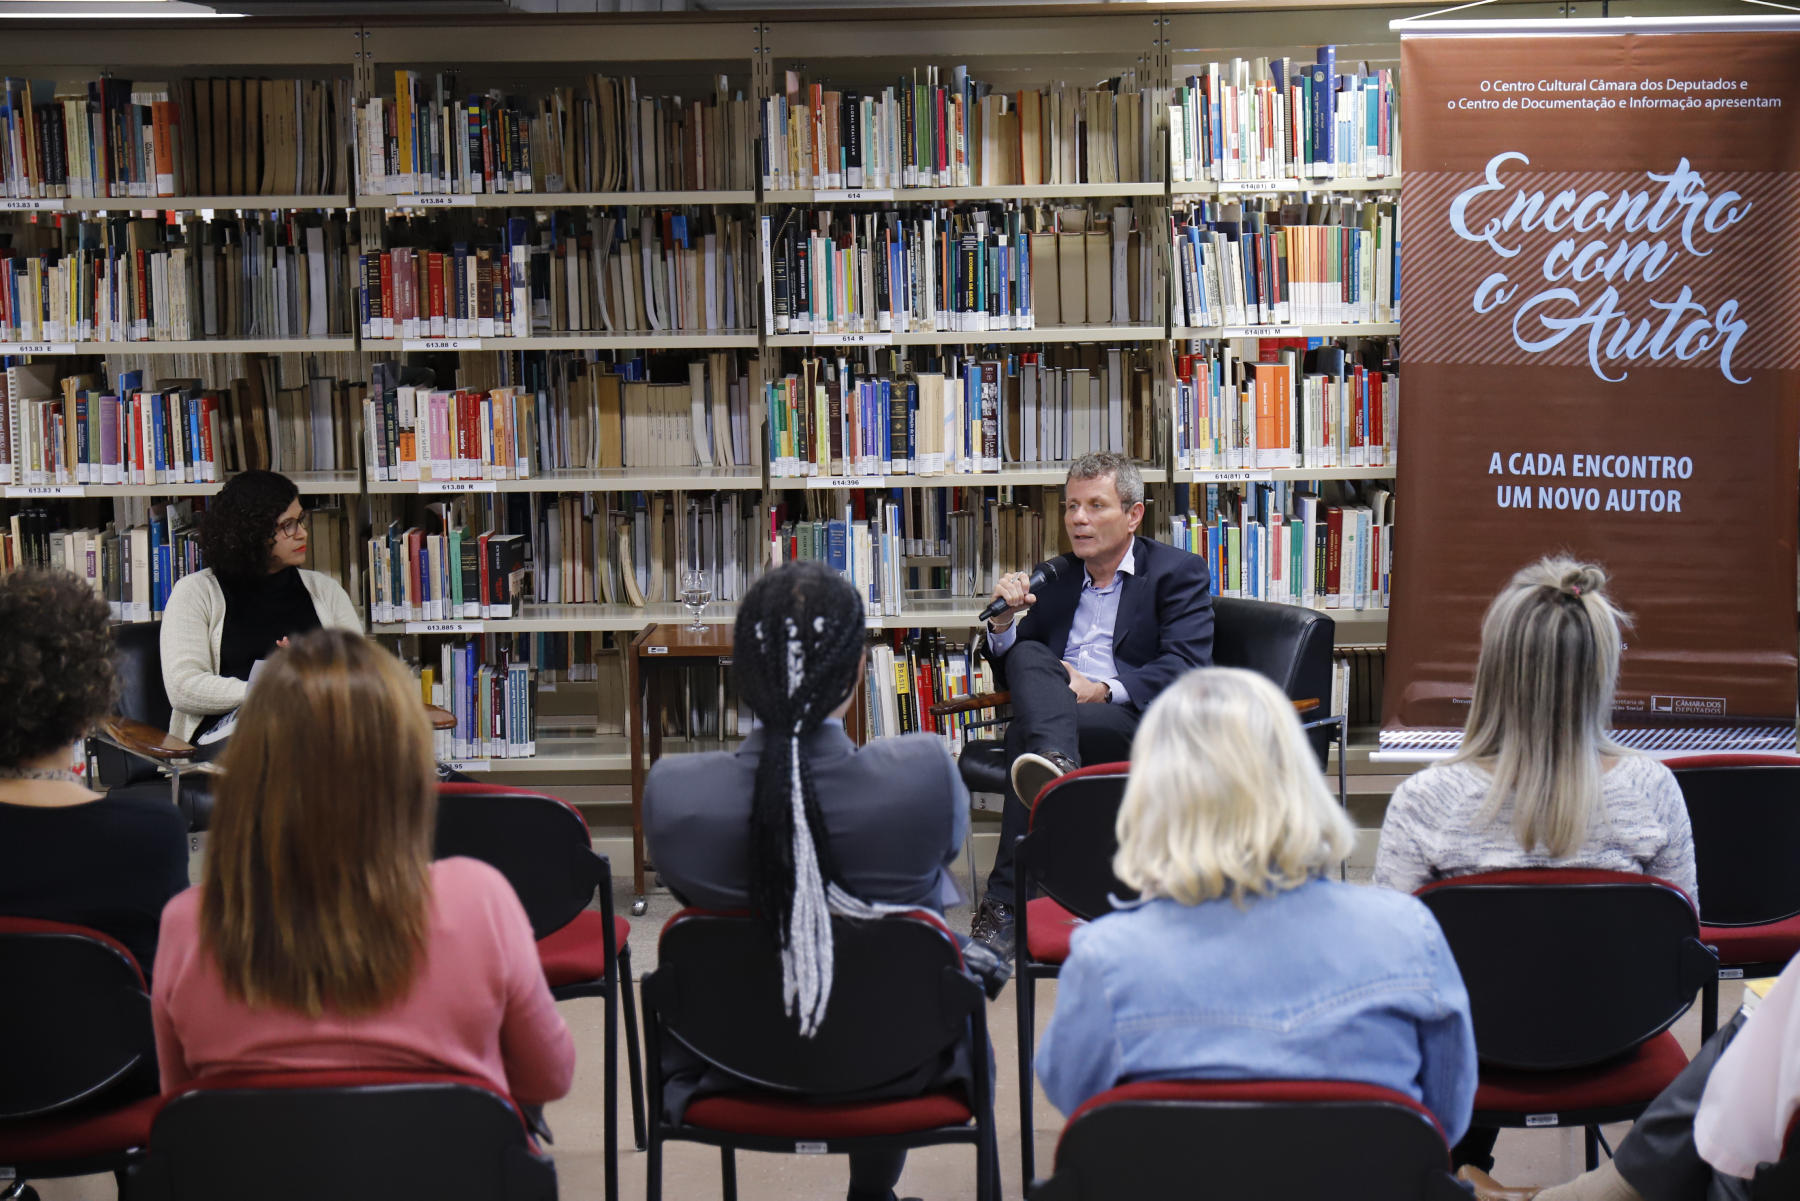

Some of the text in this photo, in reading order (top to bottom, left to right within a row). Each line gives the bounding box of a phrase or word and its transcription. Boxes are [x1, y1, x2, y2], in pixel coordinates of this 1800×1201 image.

[1480, 78, 1748, 94] O Centro Cultural Câmara dos Deputados e
[1447, 96, 1782, 112] o Centro de Documentação e Informação apresentam
[1449, 151, 1752, 258] Encontro
[1543, 238, 1679, 283] com
[1474, 272, 1518, 314] o
[1512, 285, 1752, 385] Autor
[1489, 452, 1693, 479] A CADA ENCONTRO
[1497, 486, 1681, 512] UM NOVO AUTOR
[897, 663, 906, 690] BRASIL
[1676, 706, 1721, 714] DEPUTADOS
